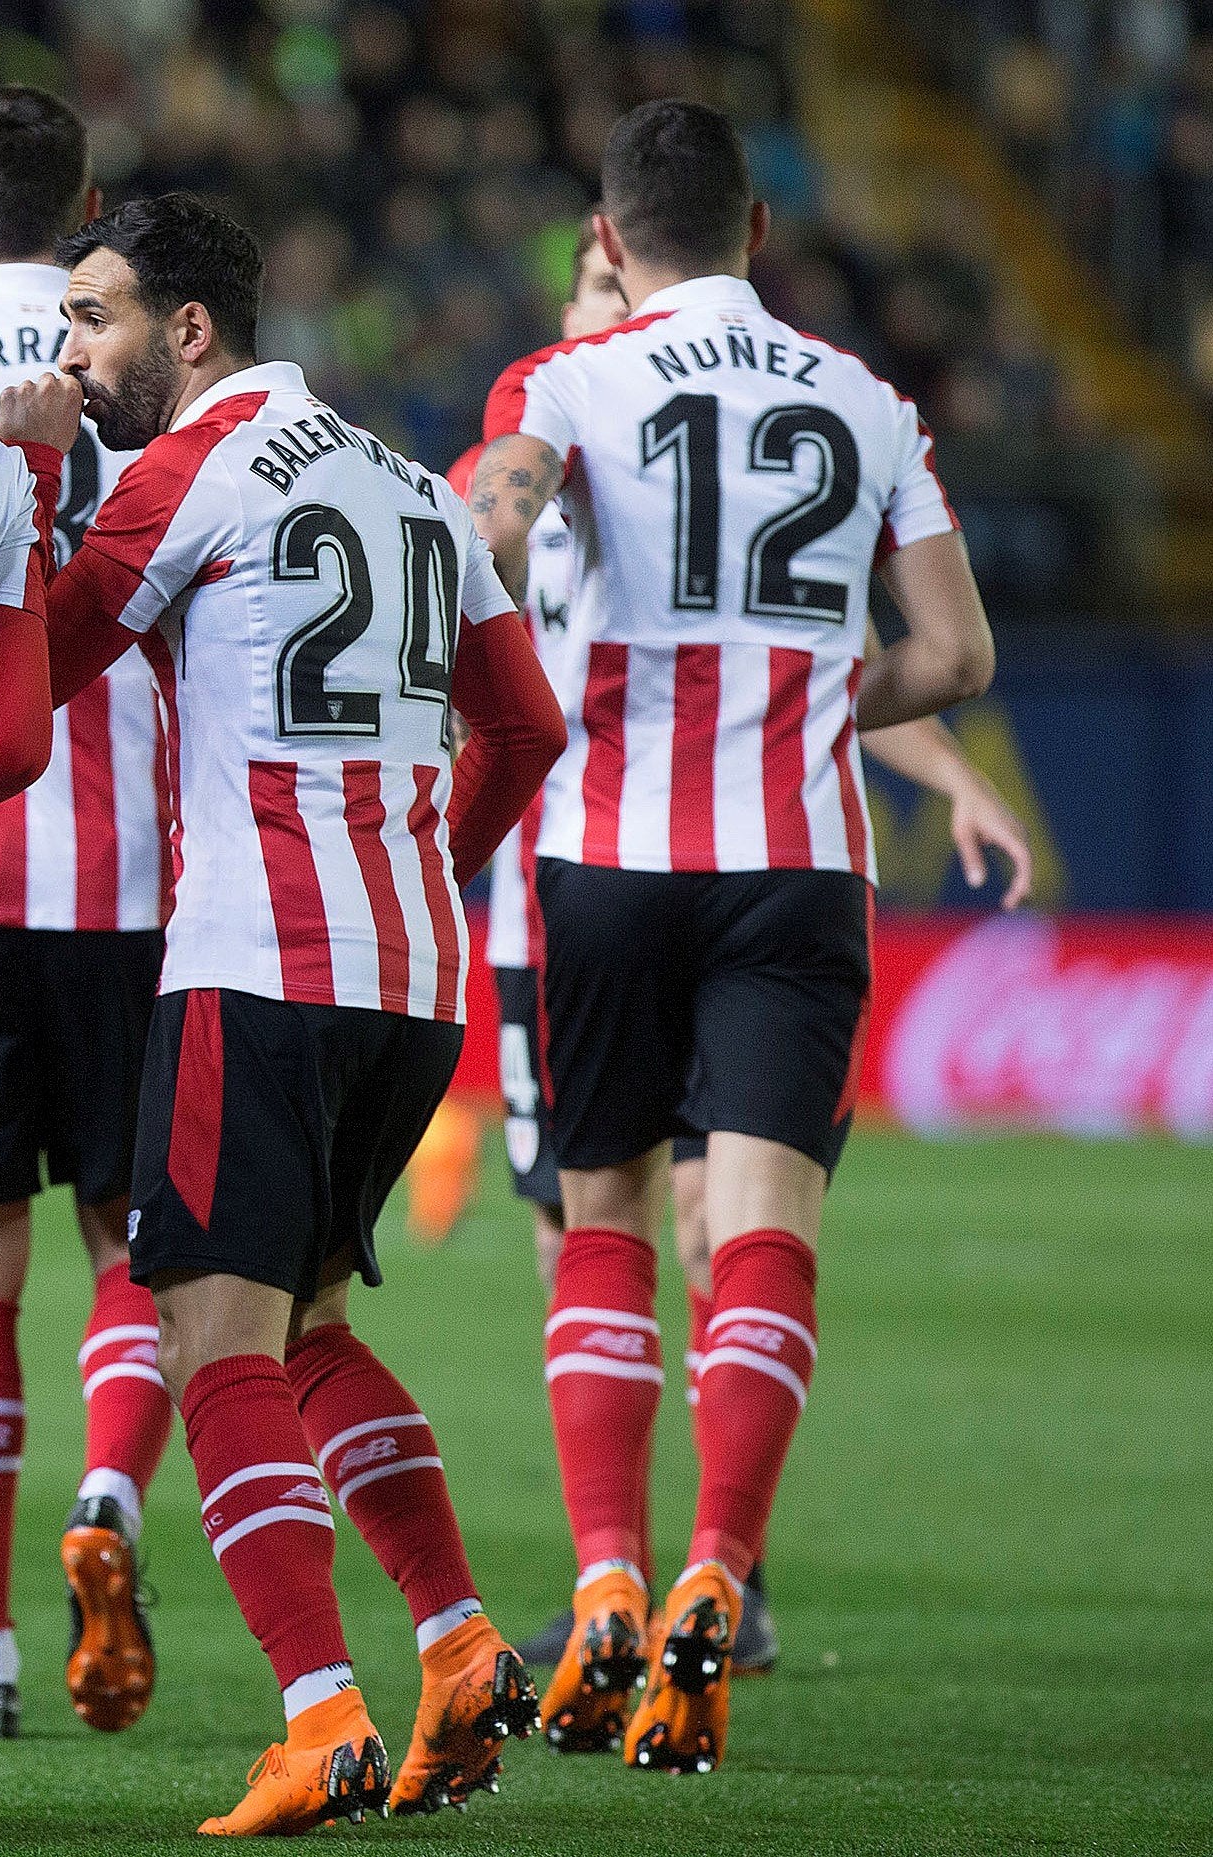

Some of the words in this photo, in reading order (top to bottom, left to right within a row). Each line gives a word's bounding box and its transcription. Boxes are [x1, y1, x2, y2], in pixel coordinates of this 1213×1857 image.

[647, 324, 821, 388] NUÑEZ
[640, 393, 861, 624] 12
[271, 502, 460, 751] 24
